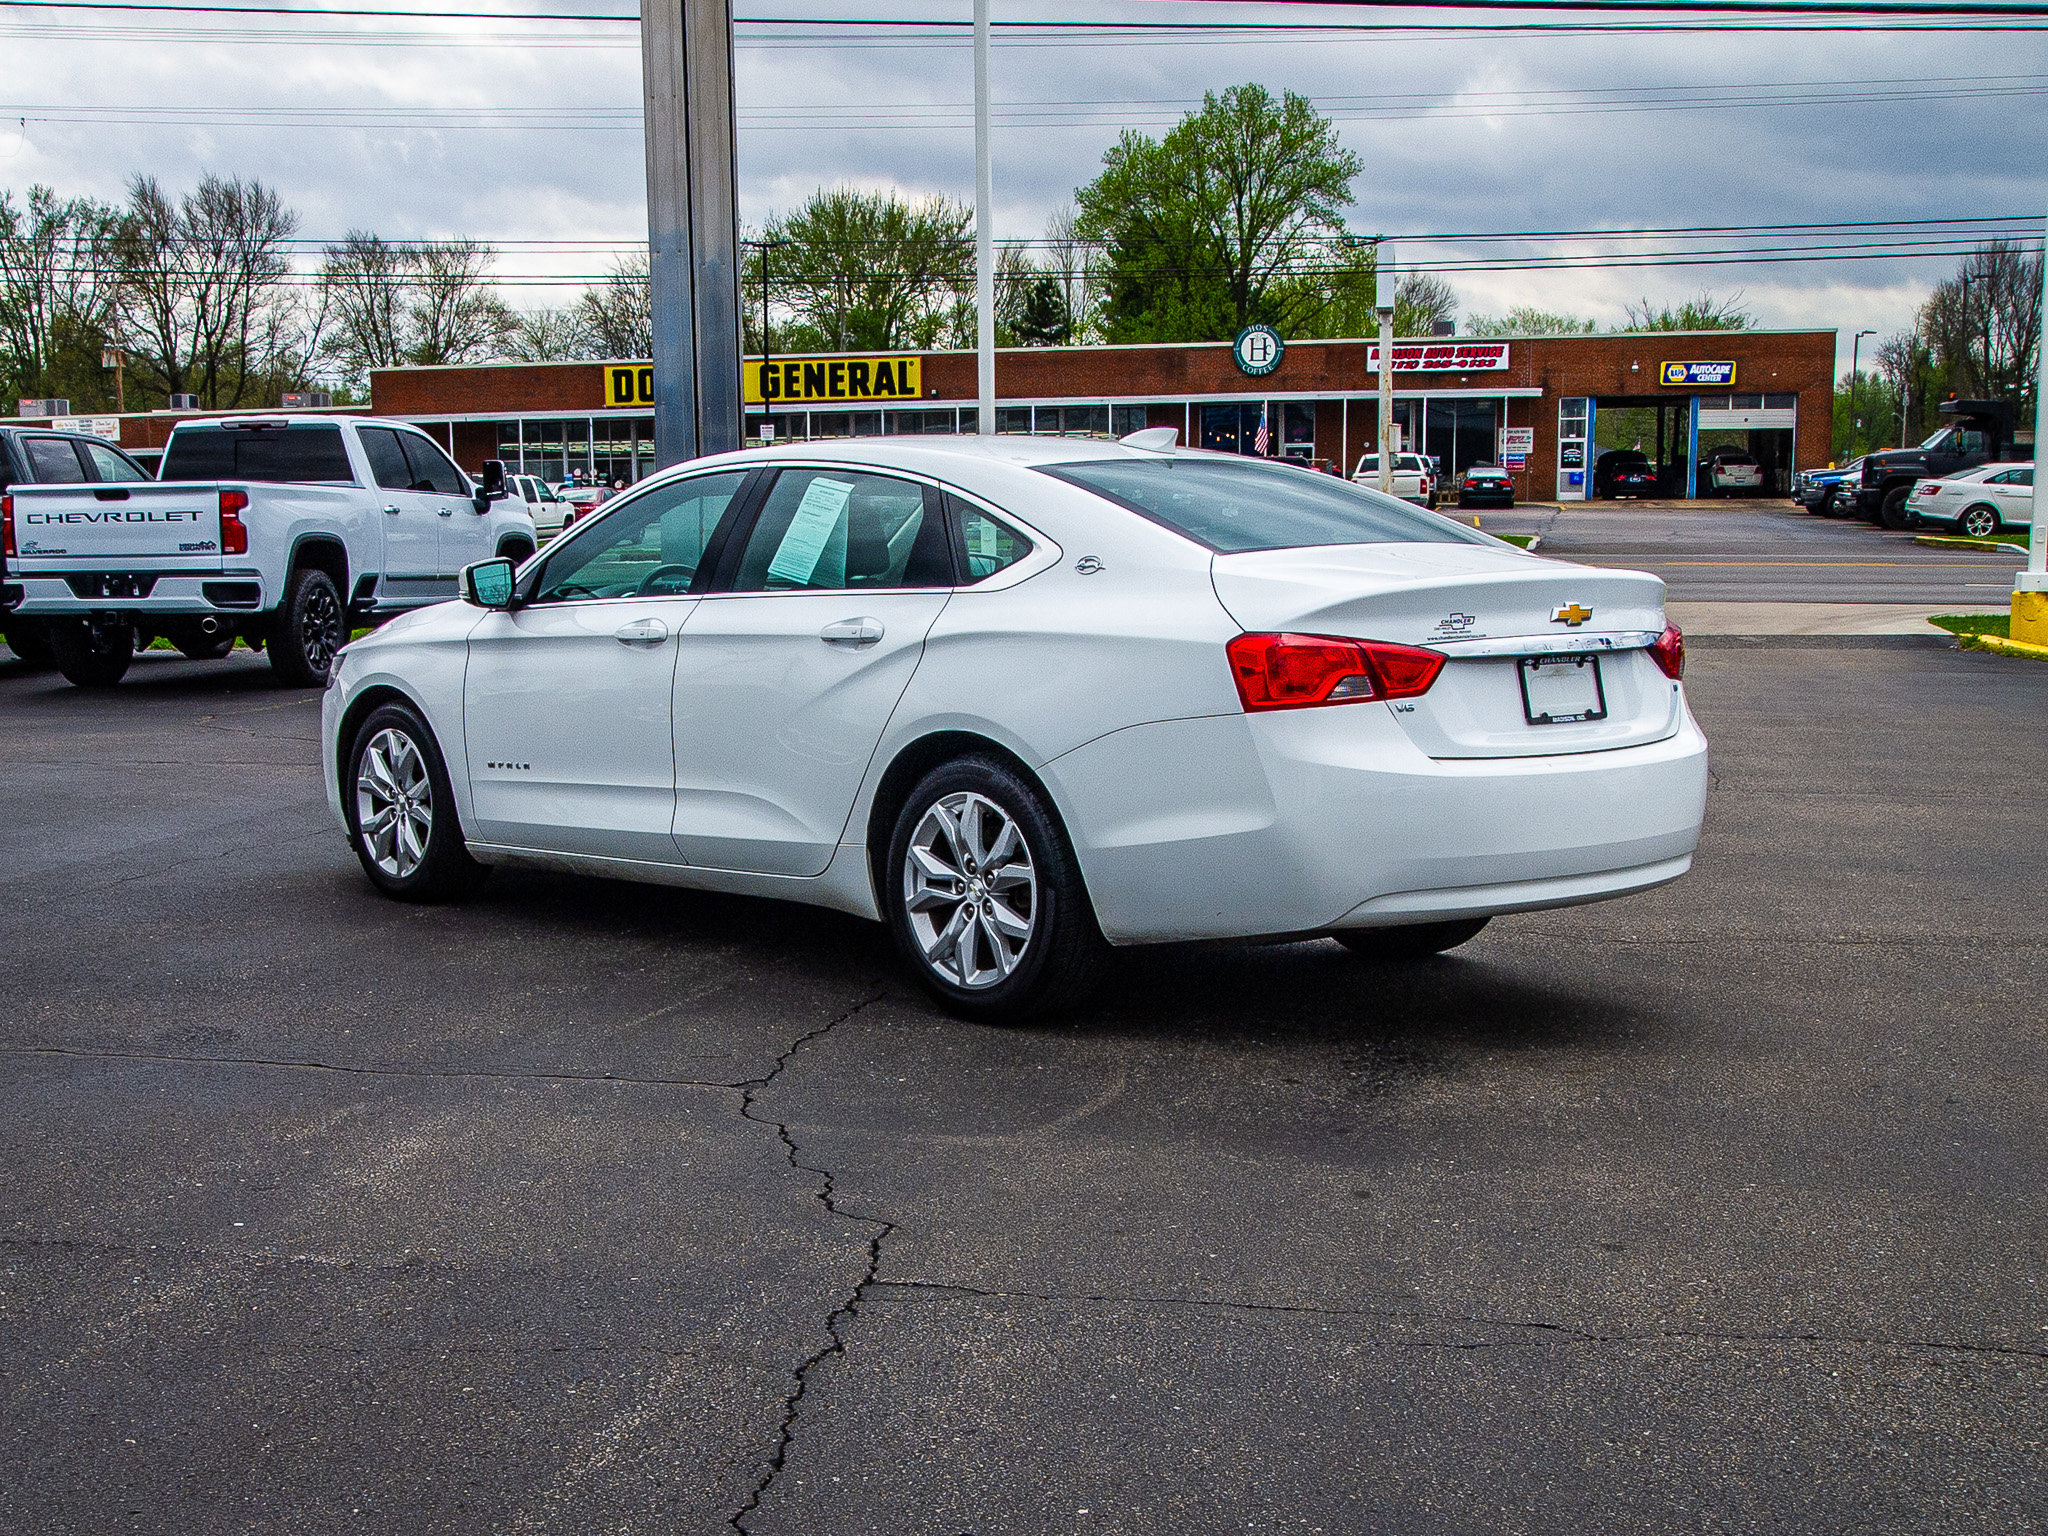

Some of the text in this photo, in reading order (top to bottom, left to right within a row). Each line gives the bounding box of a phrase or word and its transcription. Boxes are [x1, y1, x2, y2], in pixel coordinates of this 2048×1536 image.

[1370, 346, 1505, 360] MDISON AUTO SERVICE
[1243, 364, 1274, 374] COFFEE
[759, 361, 915, 398] GENERAL
[1697, 374, 1722, 382] CENTER
[26, 511, 203, 525] CHEVROLET
[1539, 656, 1581, 664] CHANDLER
[1395, 704, 1415, 712] V6
